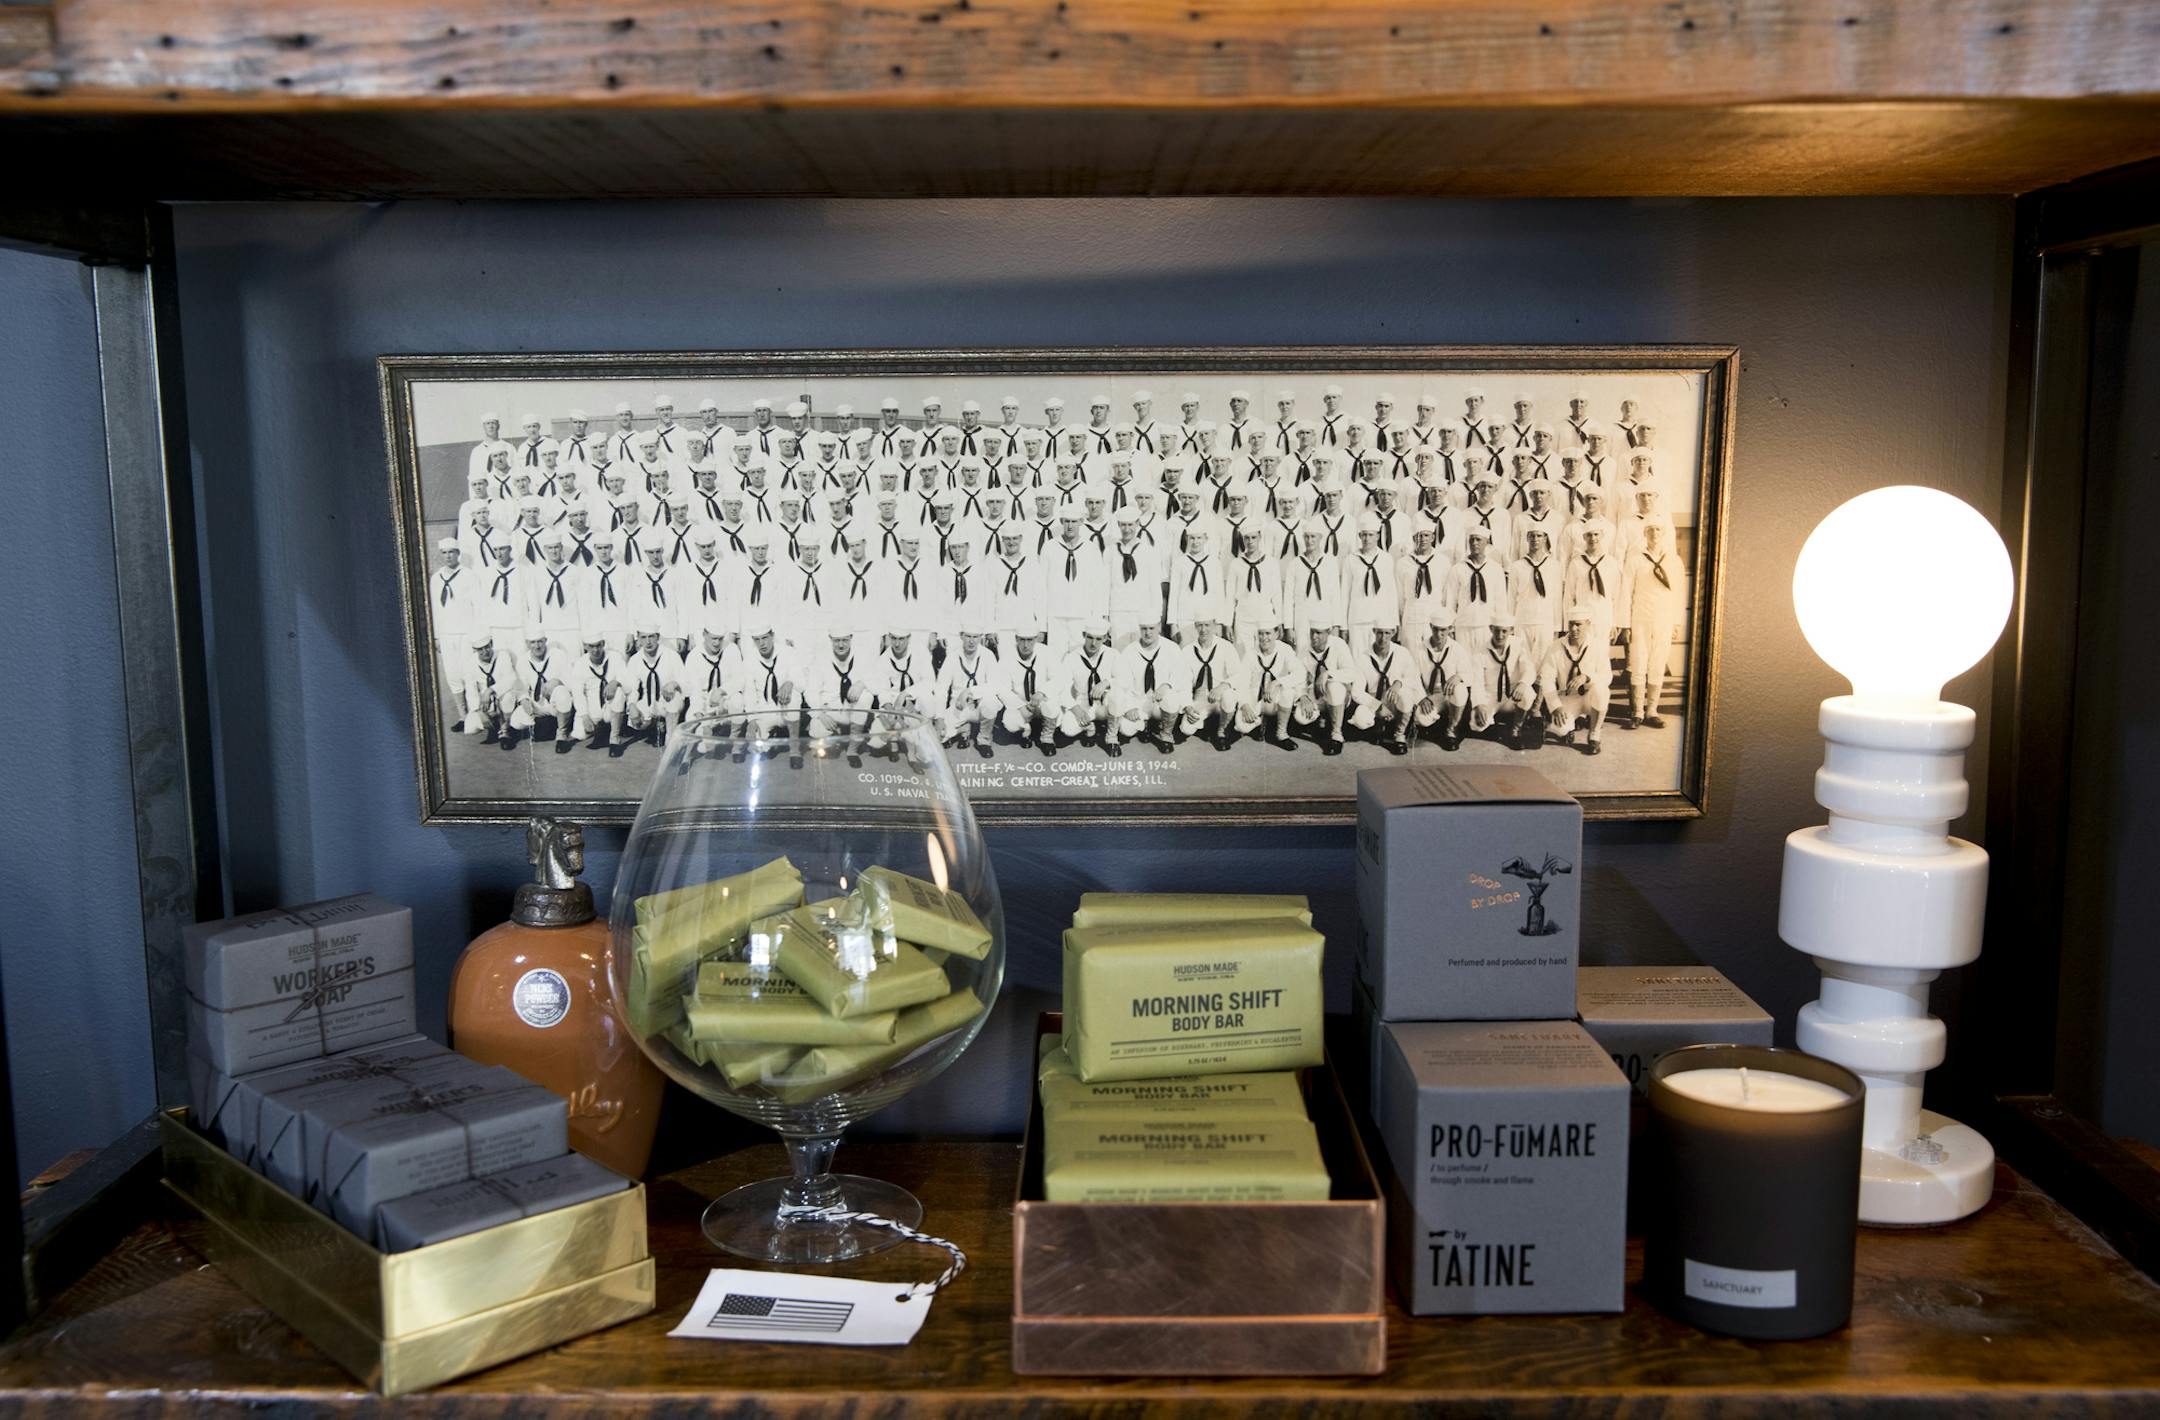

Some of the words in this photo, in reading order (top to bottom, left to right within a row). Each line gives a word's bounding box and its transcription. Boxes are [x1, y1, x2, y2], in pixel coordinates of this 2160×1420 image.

[858, 773, 878, 783] CO.
[1148, 760, 1181, 771] 1944.
[897, 788, 930, 799] NAVAL
[1103, 775, 1142, 788] LAKES,
[1173, 963, 1211, 975] HUDSON
[1448, 958, 1485, 967] Perfumed
[1487, 958, 1500, 967] and
[1502, 958, 1537, 967] produced
[1538, 958, 1547, 967] by
[1548, 957, 1568, 966] hand
[273, 956, 376, 995] WORKER'S
[1132, 993, 1223, 1018] MORNING
[1229, 988, 1283, 1011] SHIFT
[1172, 1015, 1211, 1032] BODY
[1215, 1013, 1244, 1029] BAR
[1091, 1085, 1187, 1095] MORNING
[1194, 1083, 1251, 1093] SHIFT
[1098, 1133, 1202, 1144] MORNING
[1206, 1133, 1268, 1143] SHIFT
[1430, 1176, 1462, 1186] through
[1464, 1176, 1491, 1184] smoke
[1493, 1176, 1508, 1184] and
[1454, 1229, 1467, 1240] by
[1428, 1244, 1536, 1286] TATINE
[1702, 1278, 1763, 1295] SANCTUARY
